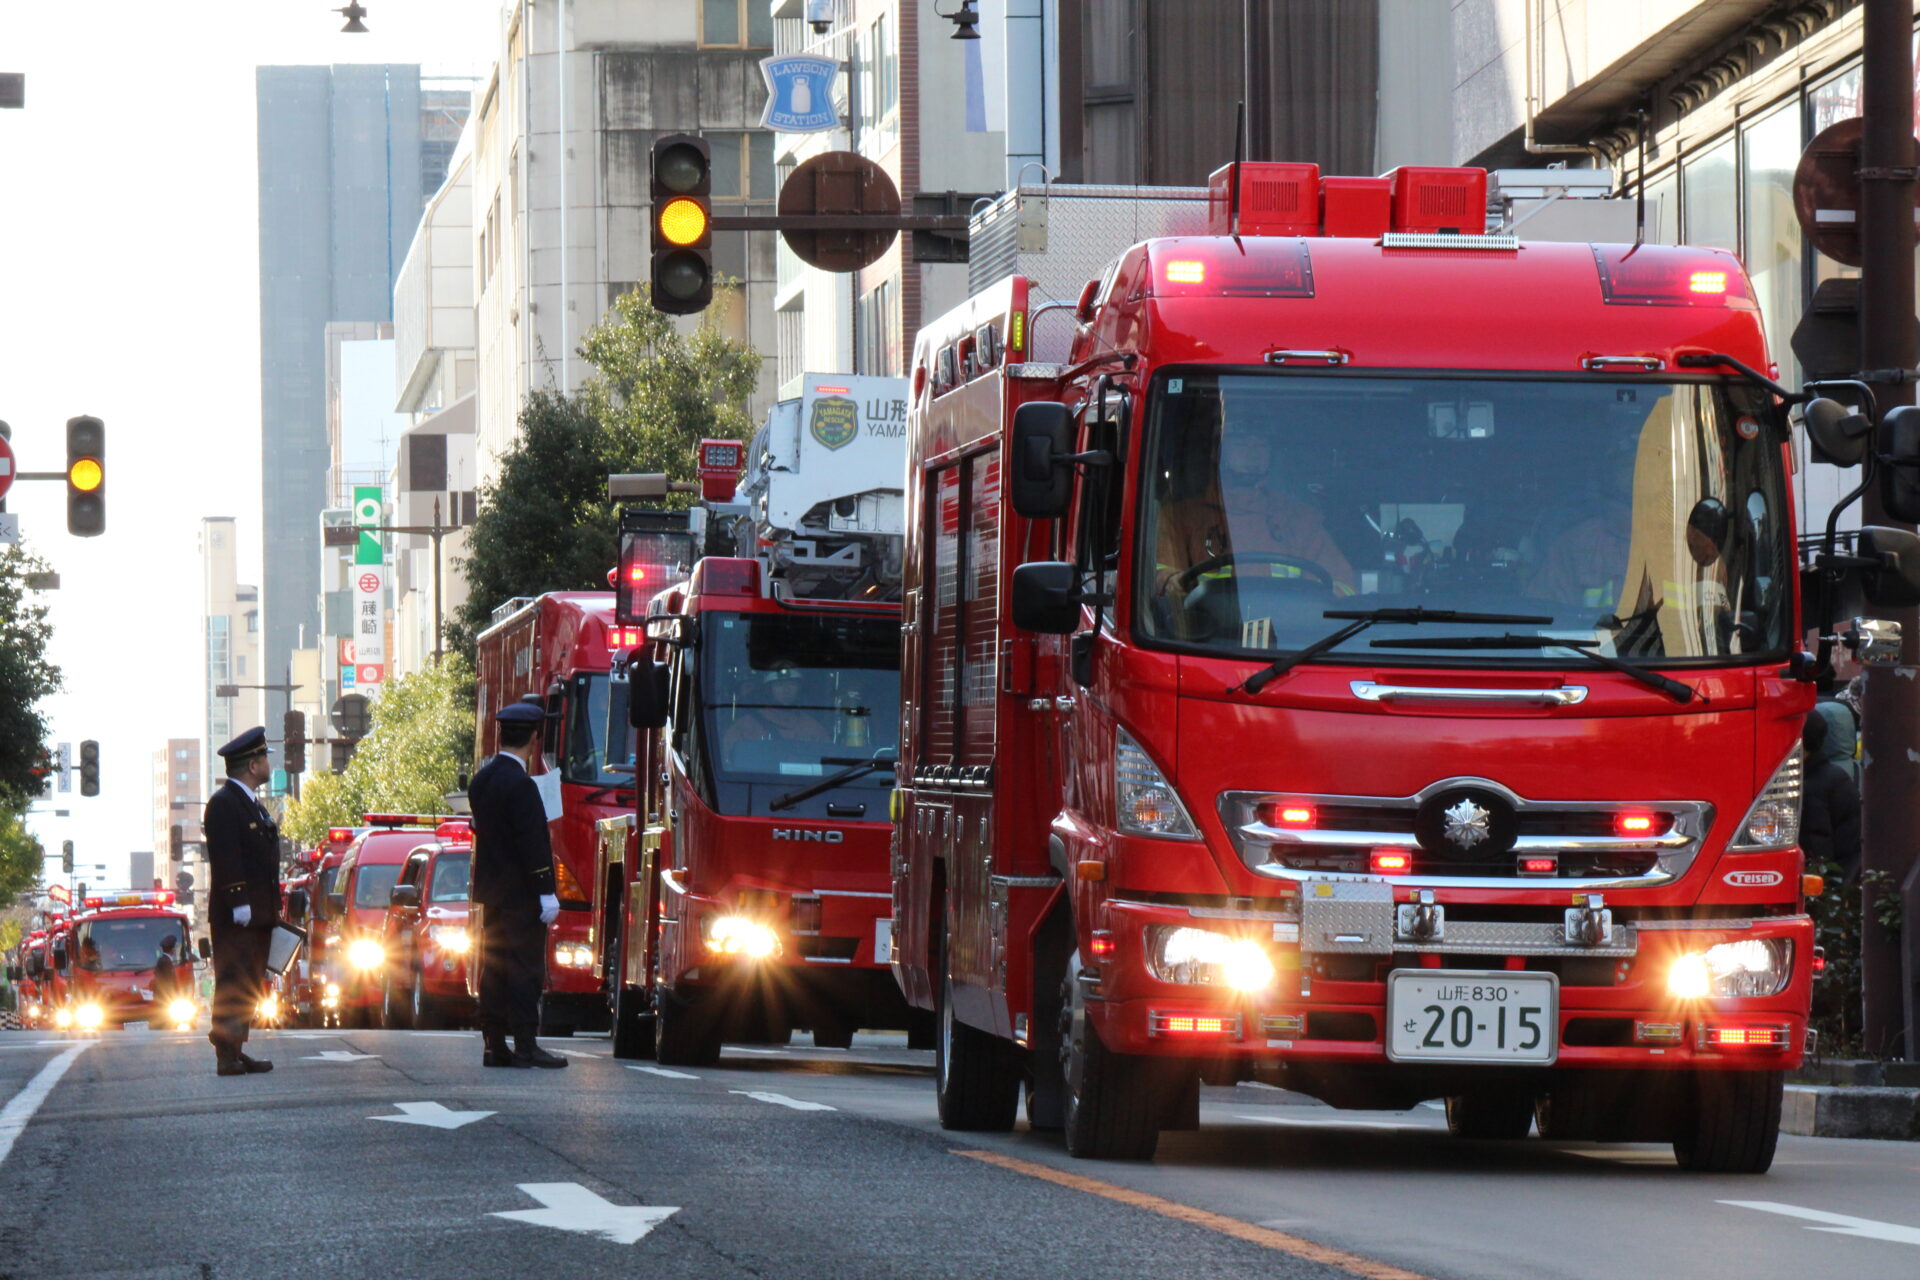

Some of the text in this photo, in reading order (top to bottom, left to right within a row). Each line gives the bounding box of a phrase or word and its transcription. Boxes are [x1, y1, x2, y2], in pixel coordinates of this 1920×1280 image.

[773, 63, 830, 77] LAWSON
[774, 112, 829, 125] STATION
[819, 407, 852, 419] YAMAGATA
[867, 423, 907, 438] YAMA
[773, 829, 843, 842] HINO
[1403, 1005, 1541, 1049] せ 20-15
